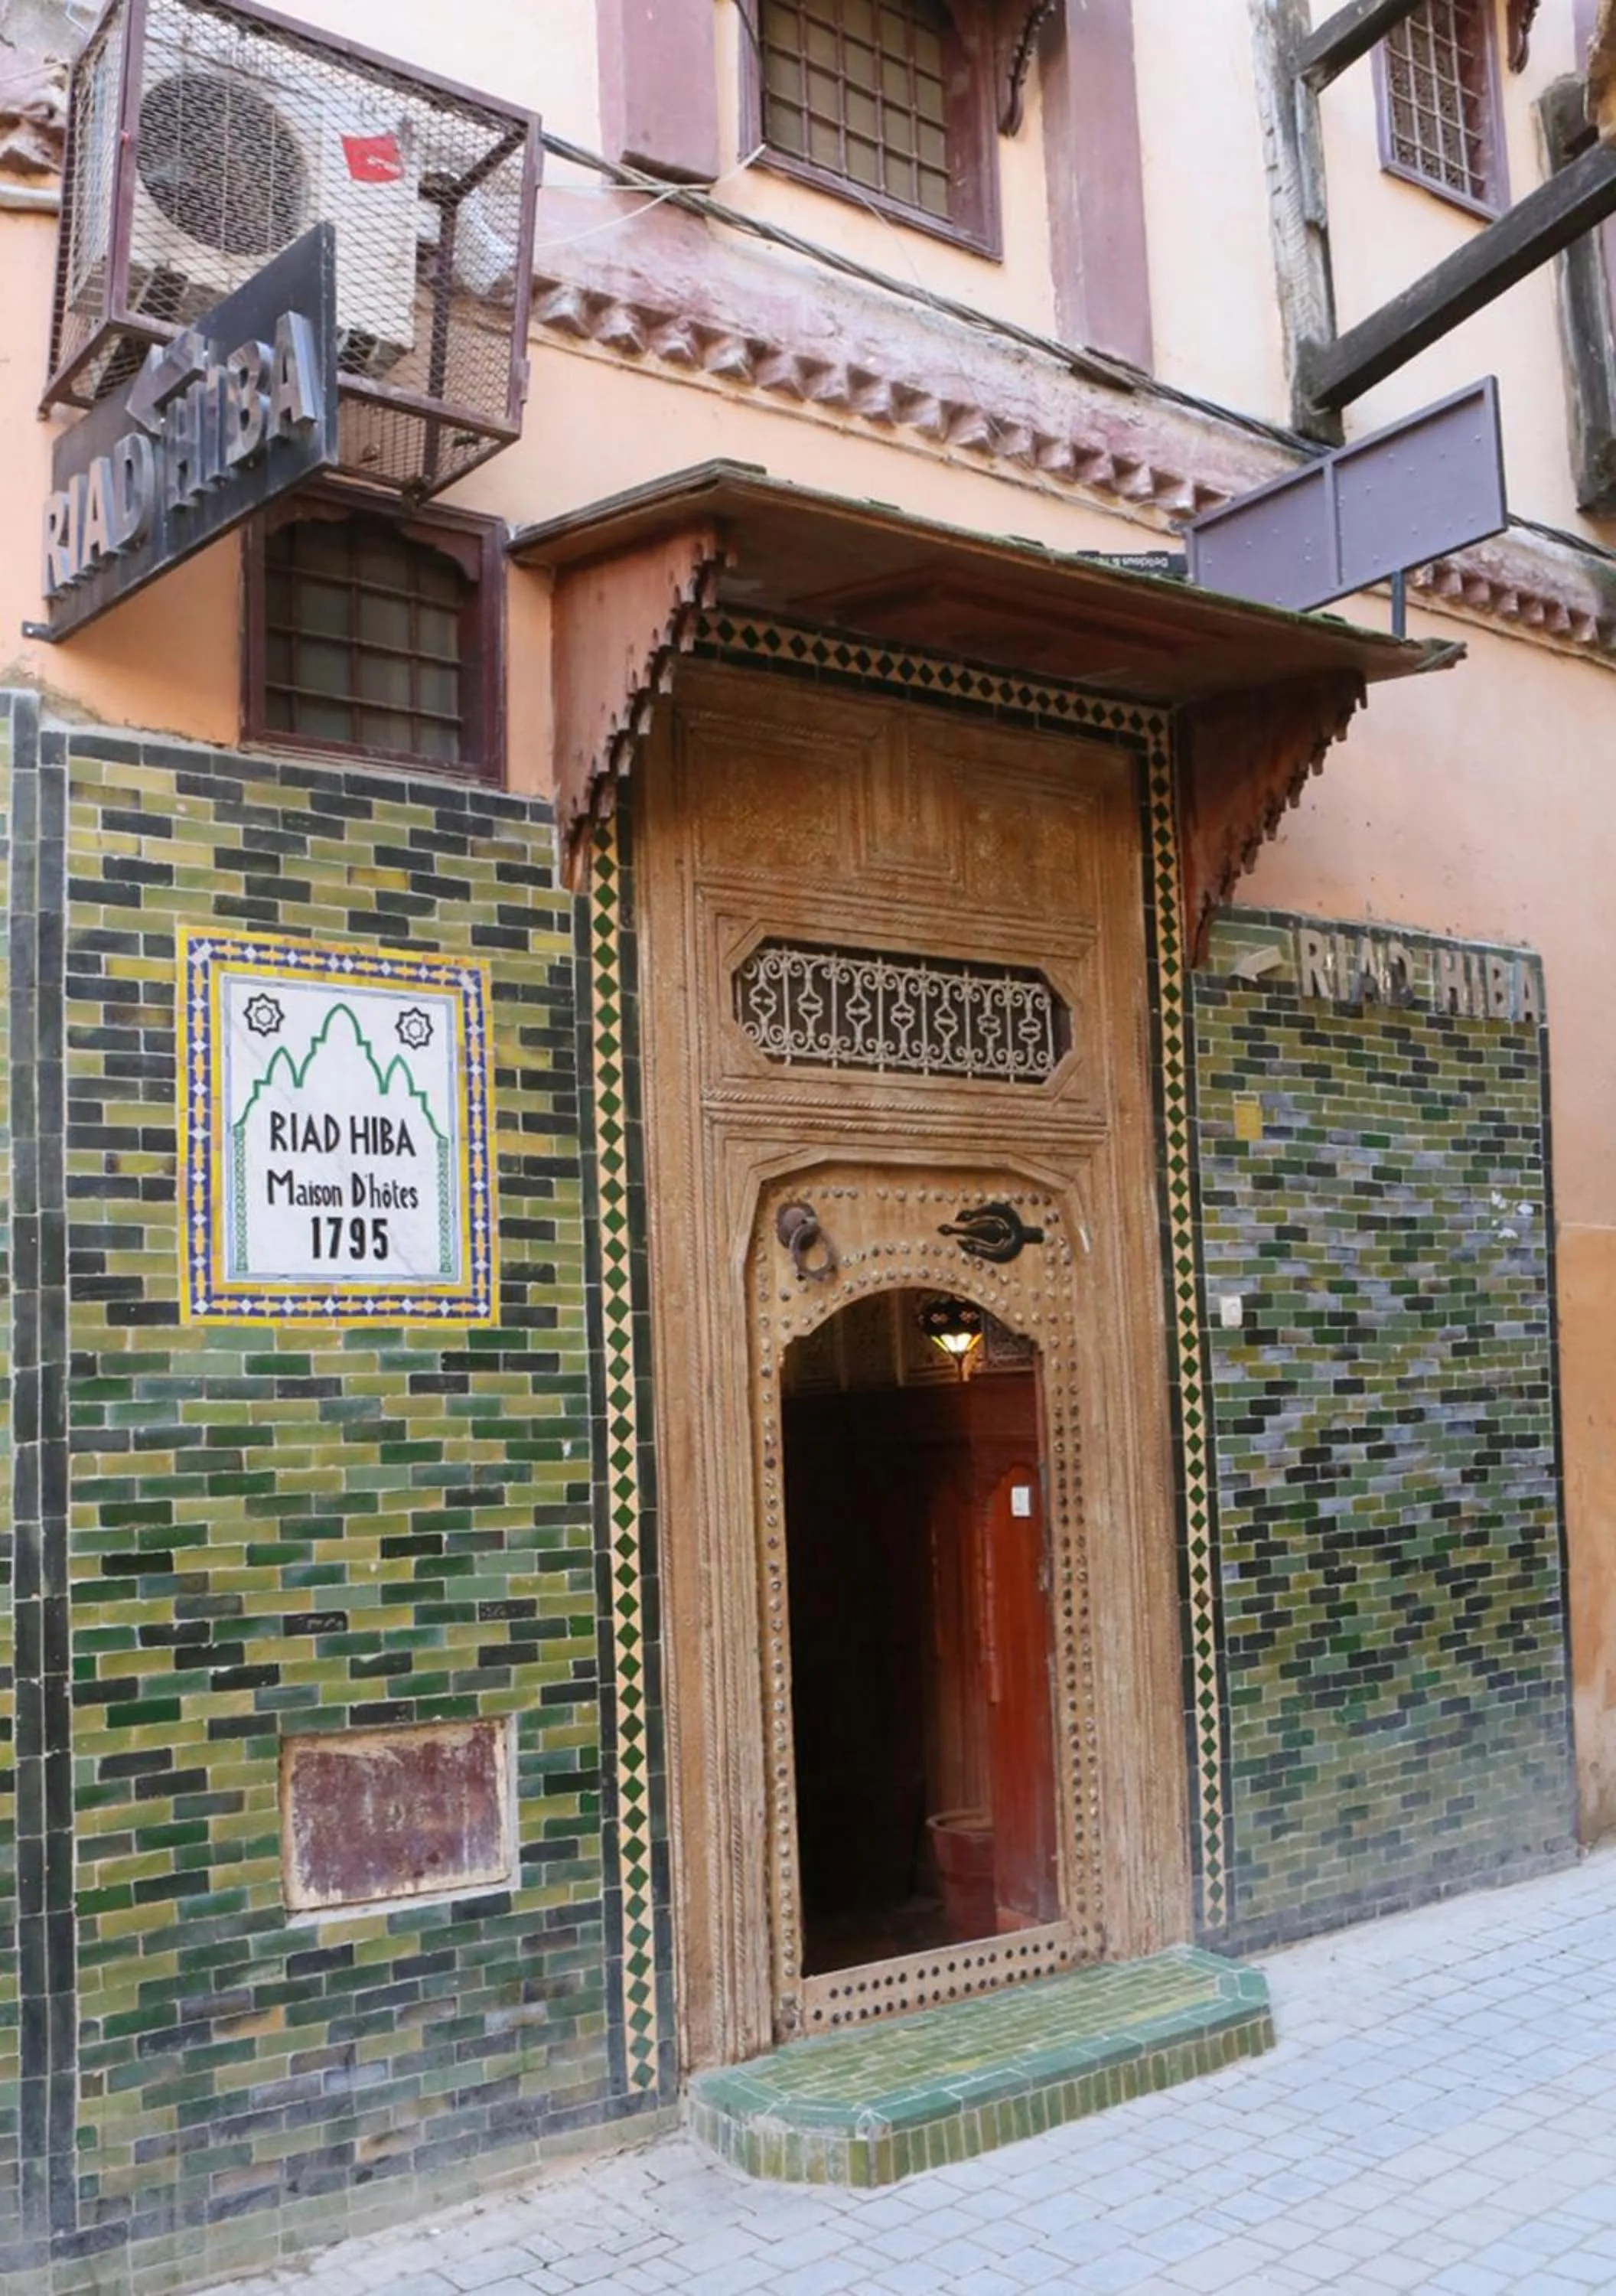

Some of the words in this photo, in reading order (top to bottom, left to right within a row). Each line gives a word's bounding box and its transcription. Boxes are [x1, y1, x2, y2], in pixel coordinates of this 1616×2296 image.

[42, 431, 155, 598] RIAD
[165, 310, 316, 508] HIBA
[1298, 928, 1415, 1006] RIAD
[1432, 948, 1540, 1022] HIBA
[270, 1110, 340, 1153] RIAD
[350, 1115, 417, 1157] HIBA
[267, 1169, 344, 1208] Maison
[311, 1216, 389, 1261] 1795
